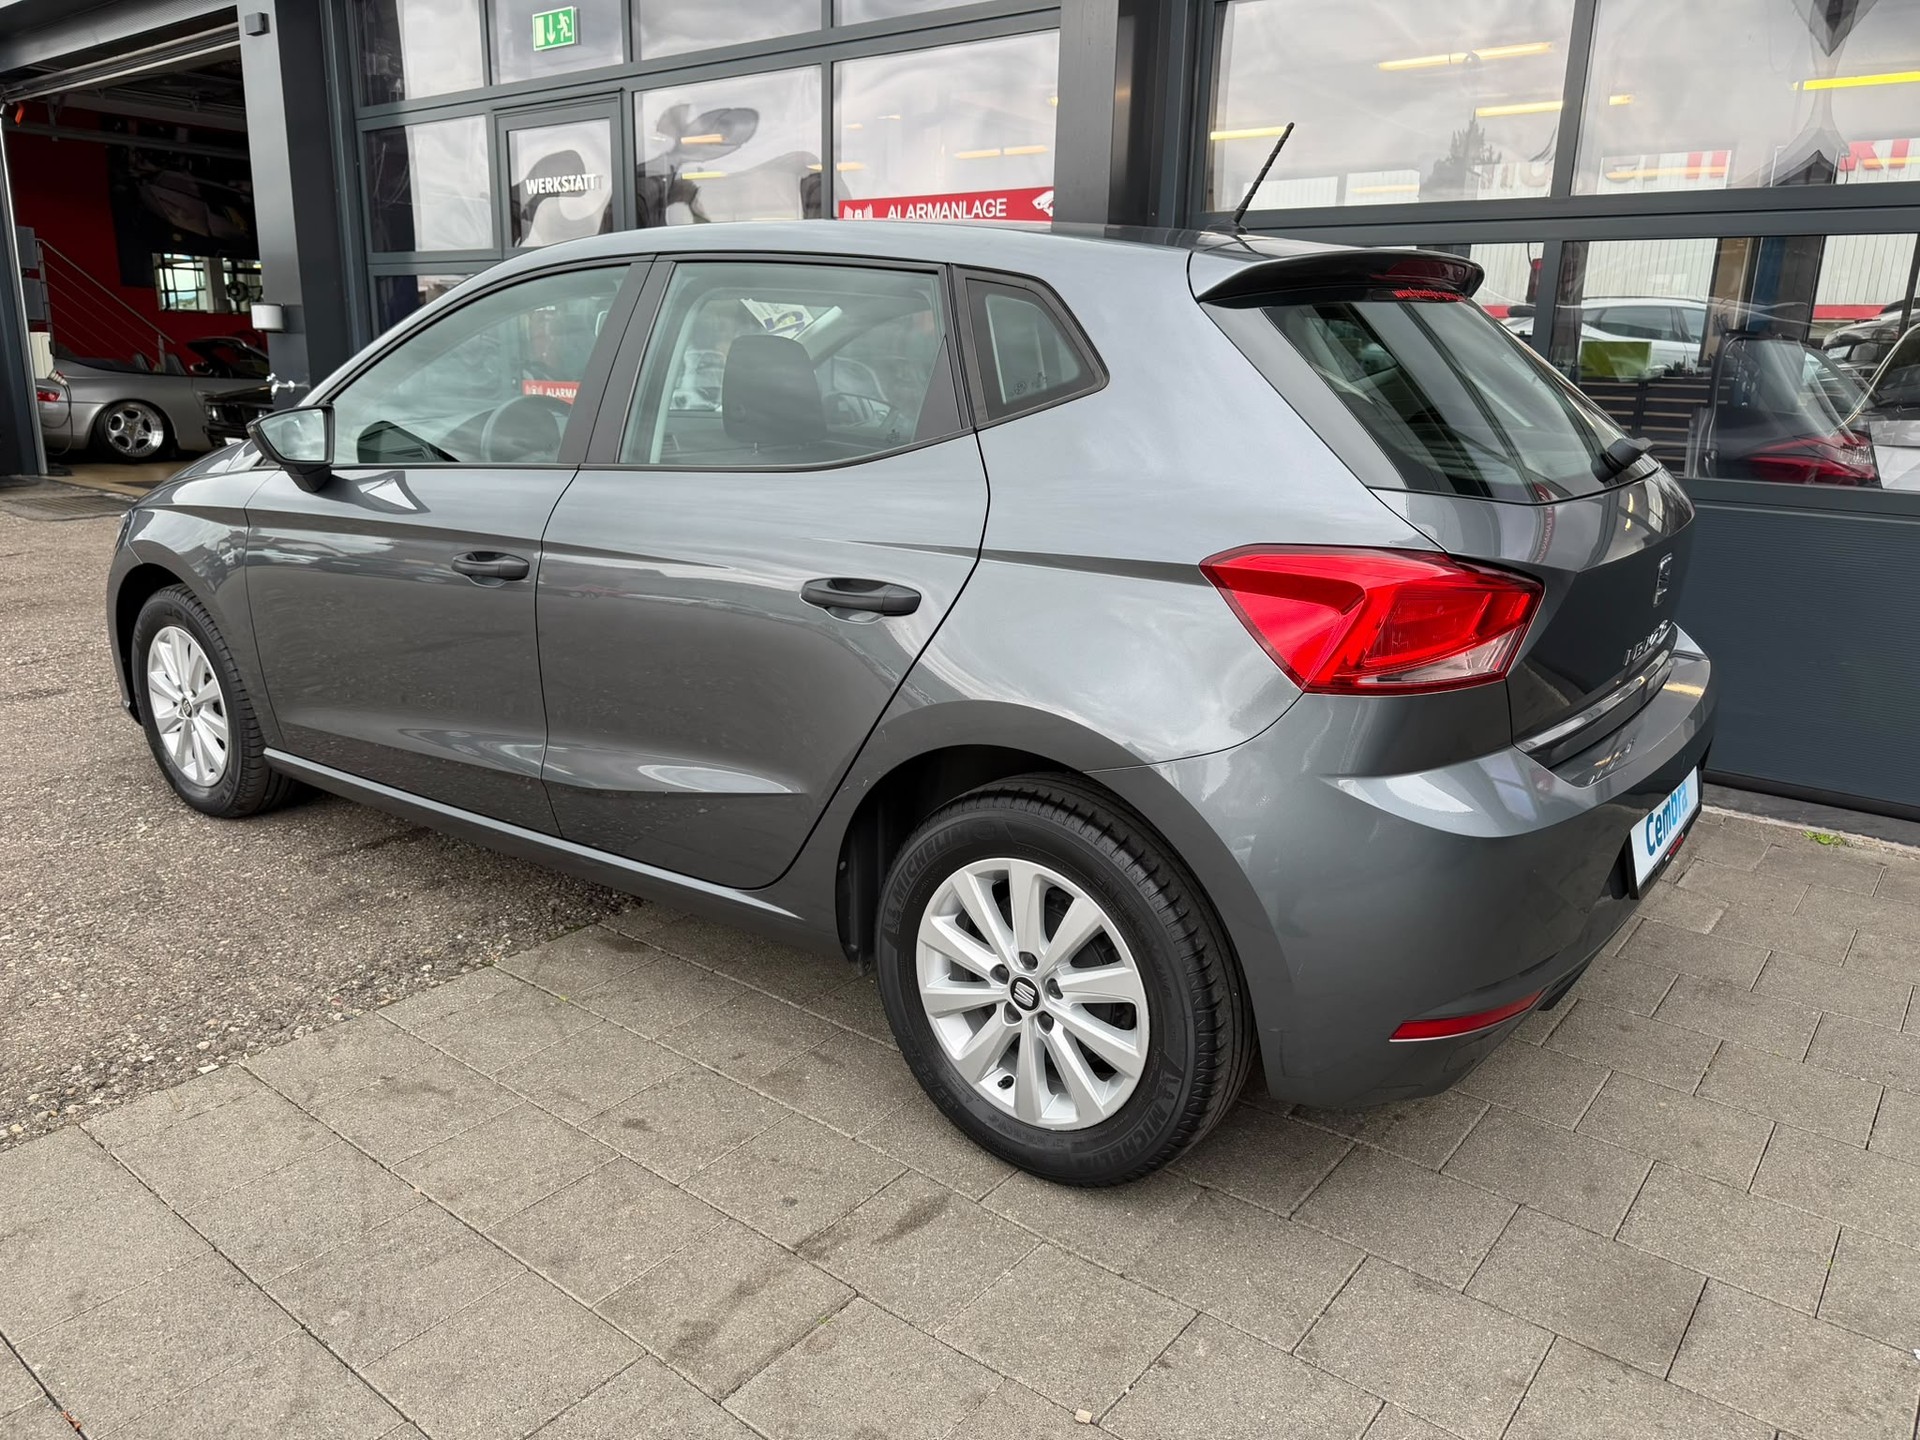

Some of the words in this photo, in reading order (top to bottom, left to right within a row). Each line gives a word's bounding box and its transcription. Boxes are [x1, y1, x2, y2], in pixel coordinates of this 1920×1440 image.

[526, 174, 597, 195] WERKSTATT
[887, 198, 1008, 219] ALARMANLAGE
[1646, 781, 1688, 856] Cembra
[1071, 1101, 1169, 1171] MICHELIN
